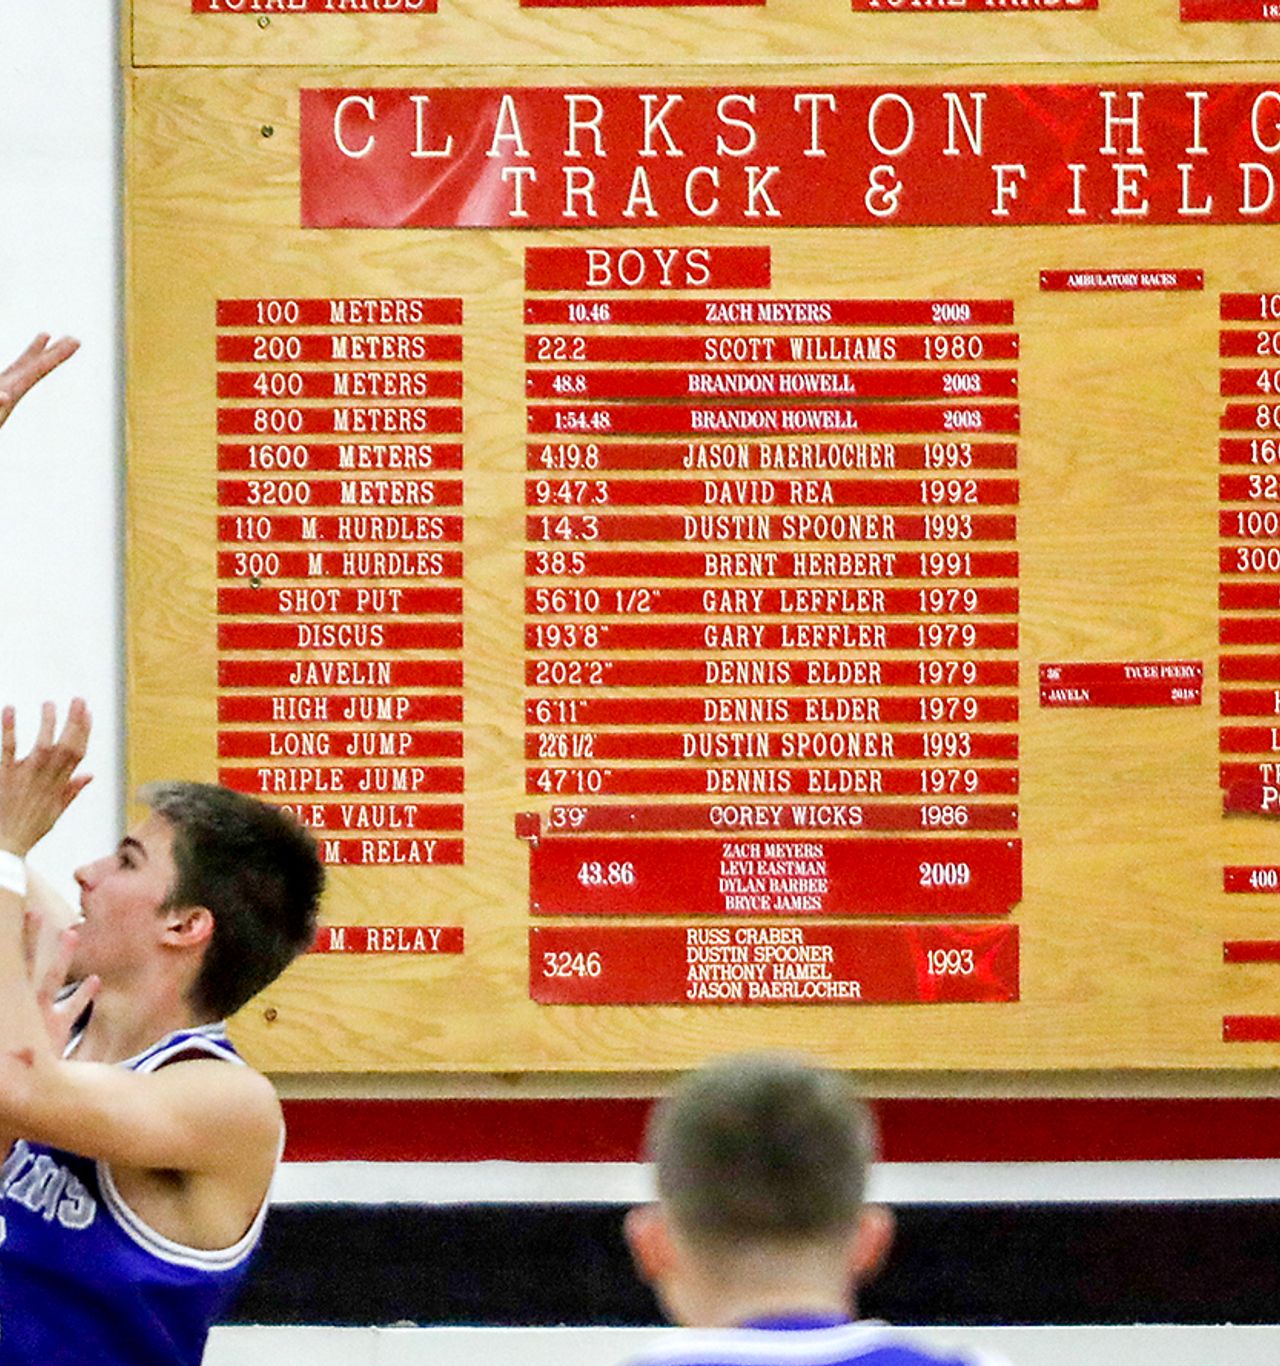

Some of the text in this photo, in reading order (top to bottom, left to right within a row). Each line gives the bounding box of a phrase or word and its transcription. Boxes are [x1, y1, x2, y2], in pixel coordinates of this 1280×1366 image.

[332, 91, 989, 159] CLARKSTON
[500, 162, 1277, 219] TRACK & FIELD
[585, 248, 710, 287] BOYS
[1067, 273, 1177, 287] AMBULATORY RACES
[257, 299, 423, 324] 100 METERS
[568, 303, 971, 322] 10.46 ZACH MEYERS 2009
[253, 335, 426, 360] 200 METERS
[537, 335, 983, 361] 22.2 SCOTT WILLIAMS 1980
[253, 372, 427, 396] 400 METERS
[552, 373, 981, 393] 48.8 BRANDON HOWELL 2003
[254, 408, 427, 433] 800 METERS
[555, 410, 982, 430] 1:54.48 BRANDON HOWELL 2003
[249, 444, 432, 469] 1600 METERS
[540, 443, 972, 470] 4:19.8 JASON BAERLOCHER 1993
[247, 480, 434, 505] 3200 METERS
[536, 479, 978, 504] 9:47.3 DAVID REA 1992
[235, 516, 271, 540] 110
[338, 516, 444, 540] HURDLES
[541, 514, 973, 541] 14.3 DUSTIN SPOONER 1993
[235, 552, 279, 578] 300
[342, 552, 443, 576] HURDLES
[536, 550, 971, 577] 38.5 BRENT HERBERT 1991
[279, 589, 402, 612] SHOT PUT
[616, 588, 660, 612] 1/2"
[702, 589, 764, 613] GARY
[780, 589, 885, 613] LEFFLER
[919, 588, 978, 613] 1979
[297, 624, 383, 648] DISCUS
[704, 625, 765, 648] GARY
[781, 624, 886, 648] LEFFLER
[918, 623, 976, 647] 1979
[289, 661, 391, 685] JAVELIN
[705, 660, 790, 684] DENNIS
[807, 661, 881, 684] ELDER
[918, 661, 977, 685] 1979
[272, 697, 410, 721] HIGH JUMP
[704, 698, 789, 722] DENNIS
[805, 698, 880, 721] ELDER
[919, 697, 978, 721] 1979
[270, 732, 412, 756] LONG JUMP
[682, 731, 770, 758] DUSTIN
[781, 731, 895, 758] SPOONER
[923, 731, 971, 758] 1993
[257, 768, 425, 792] TRIPLE JUMP
[706, 769, 791, 793] DENNIS
[807, 769, 882, 793] ELDER
[920, 769, 978, 793] 1979
[341, 805, 417, 828] VAULT
[709, 804, 968, 828] COREY WICKS 1986
[361, 840, 437, 863] RELAY
[722, 843, 824, 859] ZACH MEYERS
[577, 861, 635, 886] 43.86
[720, 860, 826, 876] LEVI EASTMAN
[919, 862, 970, 887] 2009
[719, 877, 828, 894] DYLAN BARBEE
[725, 895, 822, 911] BRYCE JAMES
[366, 928, 441, 951] RELAY
[686, 928, 804, 945] RUSS CRABER
[686, 945, 834, 963] DUSTIN SPOONER
[927, 949, 974, 975] 1993
[686, 963, 833, 981] ANTHONY HAMEL
[686, 980, 861, 999] JASON BAERLOCHER
